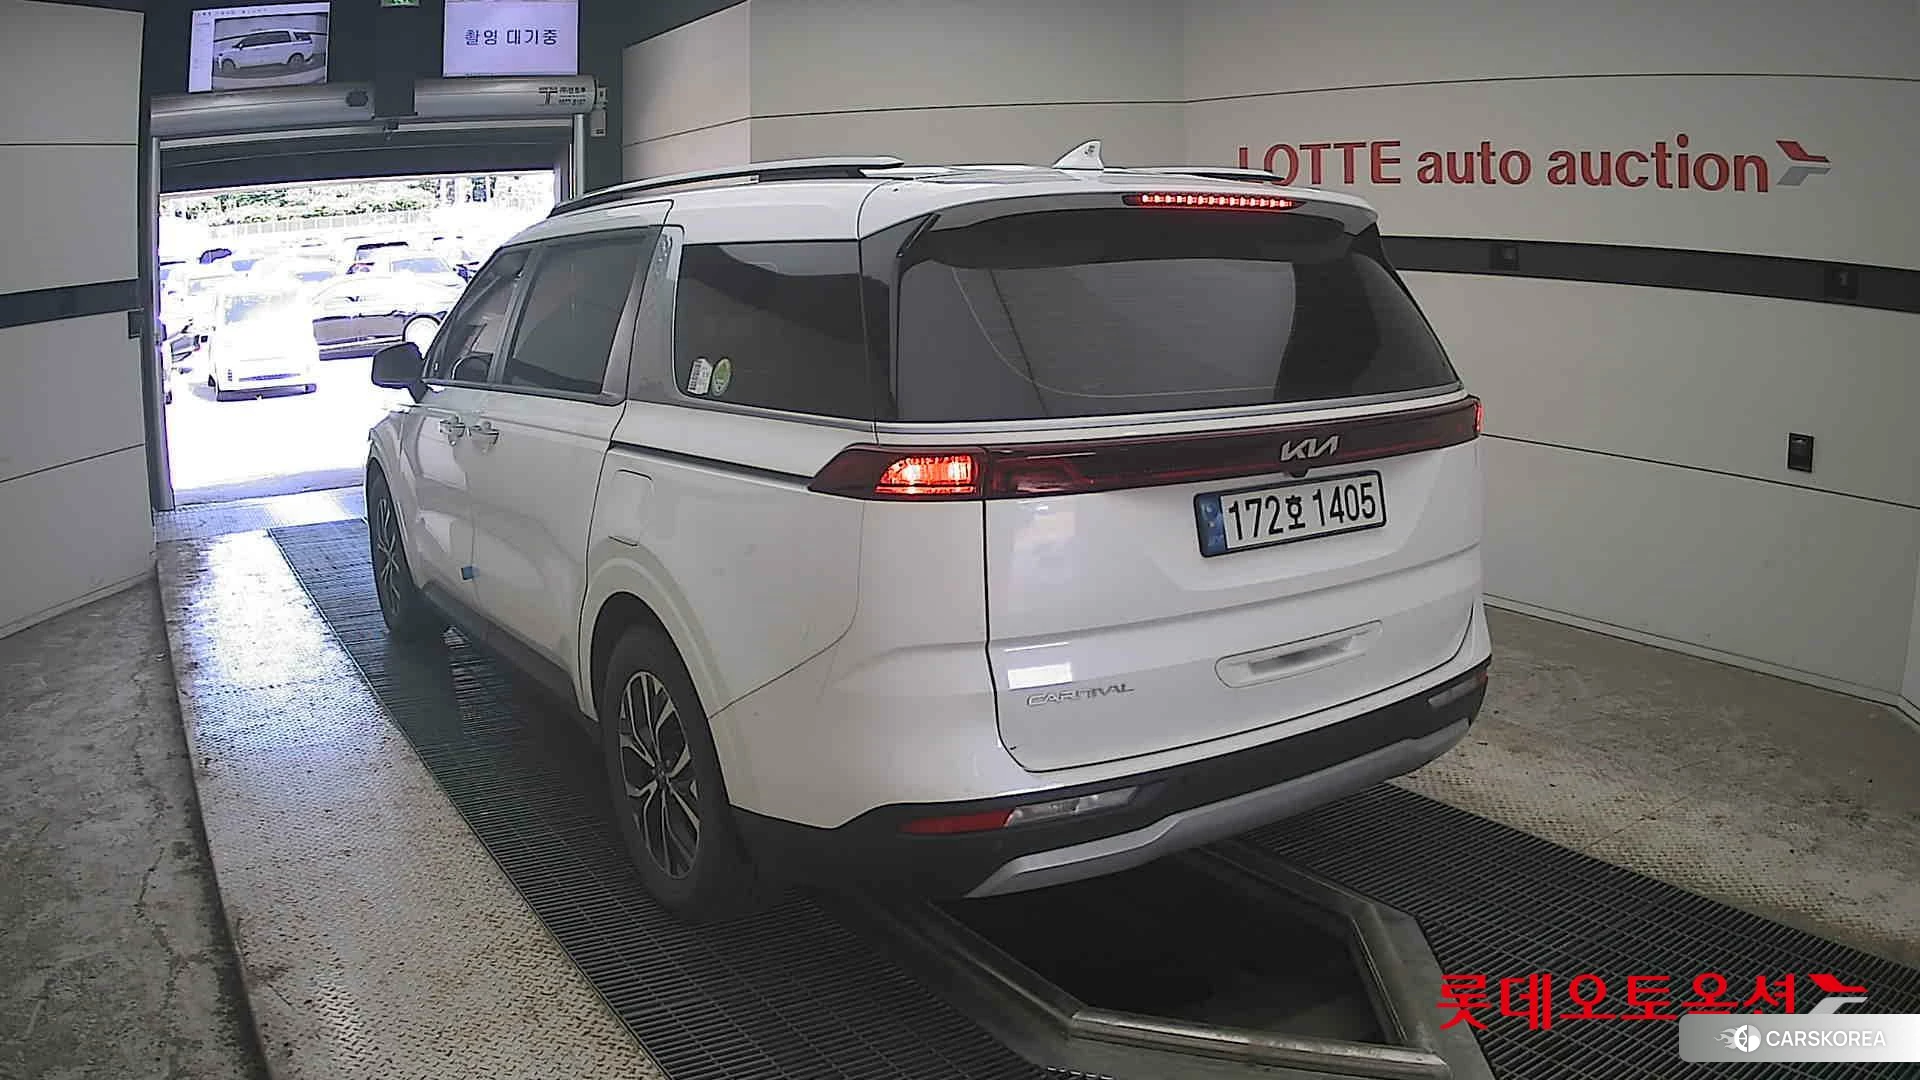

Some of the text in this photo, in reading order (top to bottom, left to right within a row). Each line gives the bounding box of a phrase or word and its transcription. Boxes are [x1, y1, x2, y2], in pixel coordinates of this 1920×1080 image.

[464, 29, 558, 46] 촬영 대기중
[1416, 141, 1532, 185] auto
[1547, 133, 1769, 193] auction
[1280, 436, 1341, 462] KIA
[1228, 482, 1377, 541] 172호 1405
[1026, 683, 1136, 707] CARNIVAL
